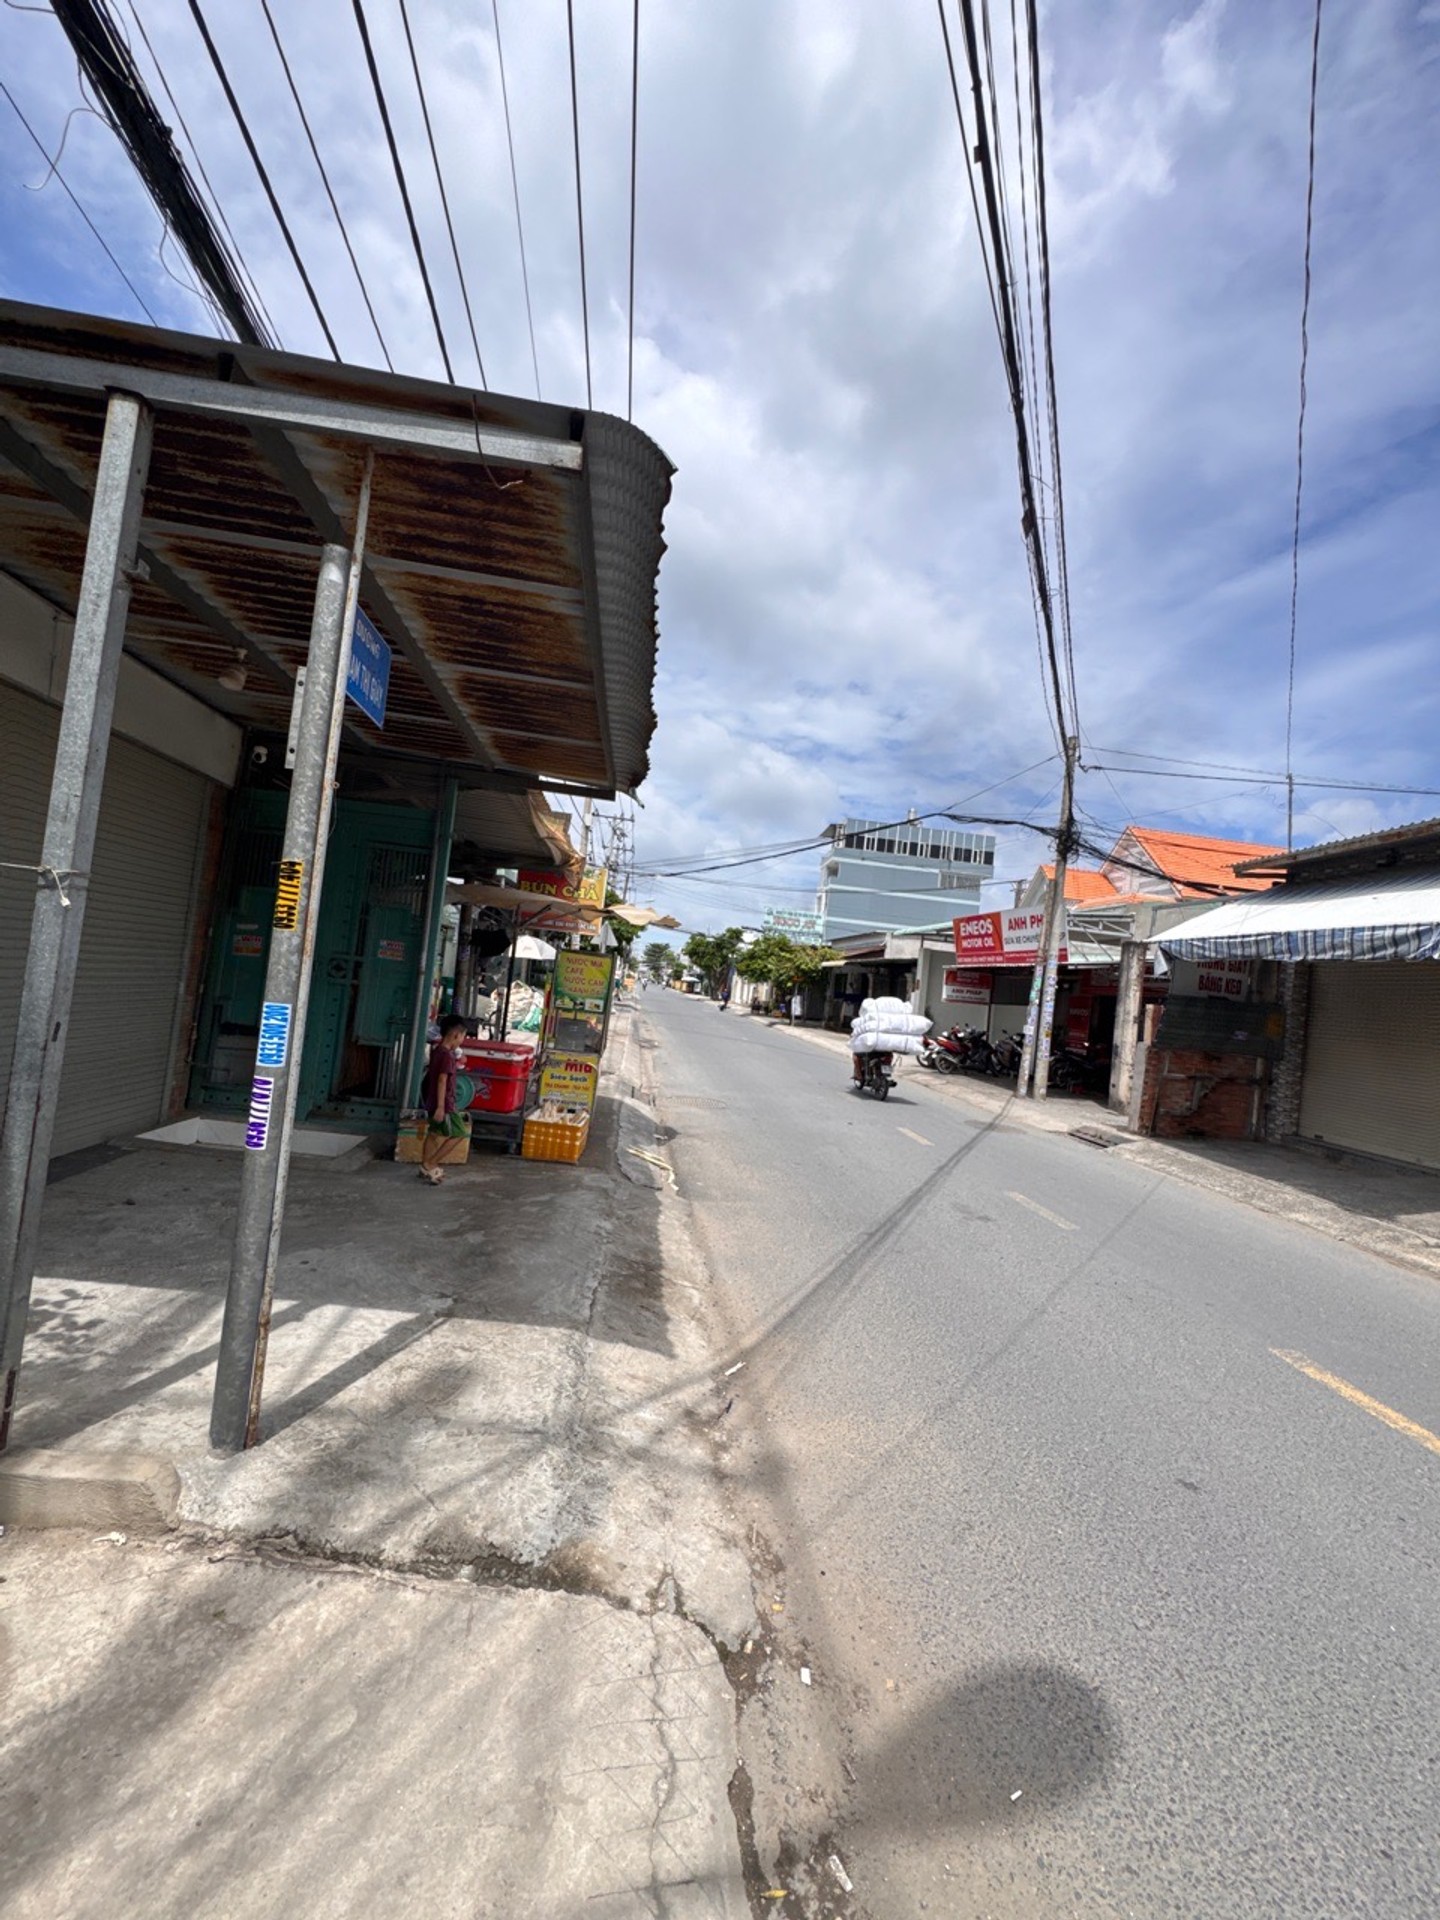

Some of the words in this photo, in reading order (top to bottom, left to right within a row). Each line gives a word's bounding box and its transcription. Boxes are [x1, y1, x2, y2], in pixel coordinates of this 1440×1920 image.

[959, 918, 993, 937] ENEOS
[1007, 915, 1027, 931] ANH
[961, 938, 983, 949] MOTOR
[983, 936, 995, 948] OIL
